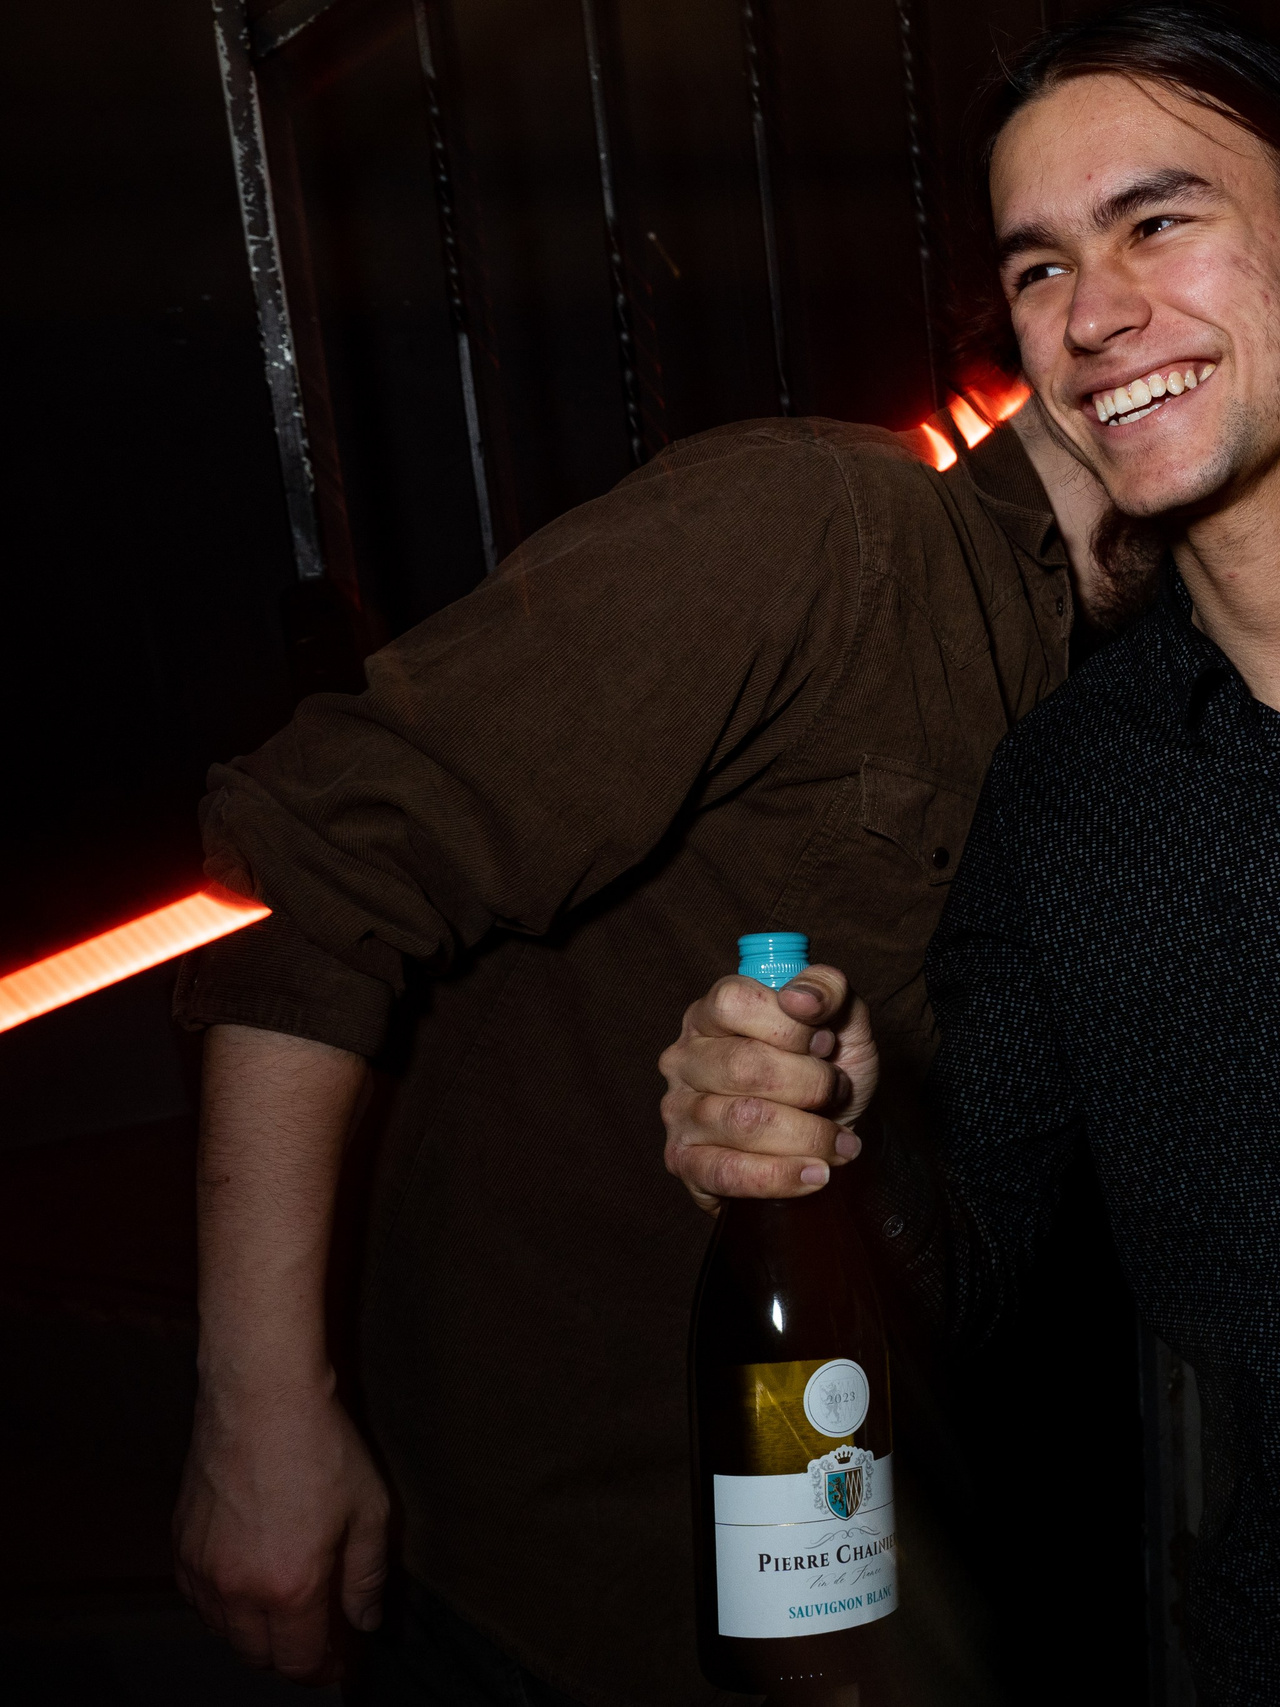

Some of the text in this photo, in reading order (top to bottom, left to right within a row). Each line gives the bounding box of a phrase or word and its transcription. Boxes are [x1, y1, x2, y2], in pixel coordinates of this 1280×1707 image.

[826, 1391, 856, 1405] 2023
[758, 1553, 830, 1573] PIERRE
[807, 1574, 830, 1590] Vin
[833, 1572, 847, 1585] de
[789, 1584, 892, 1619] SAUVIGNON BLANC
